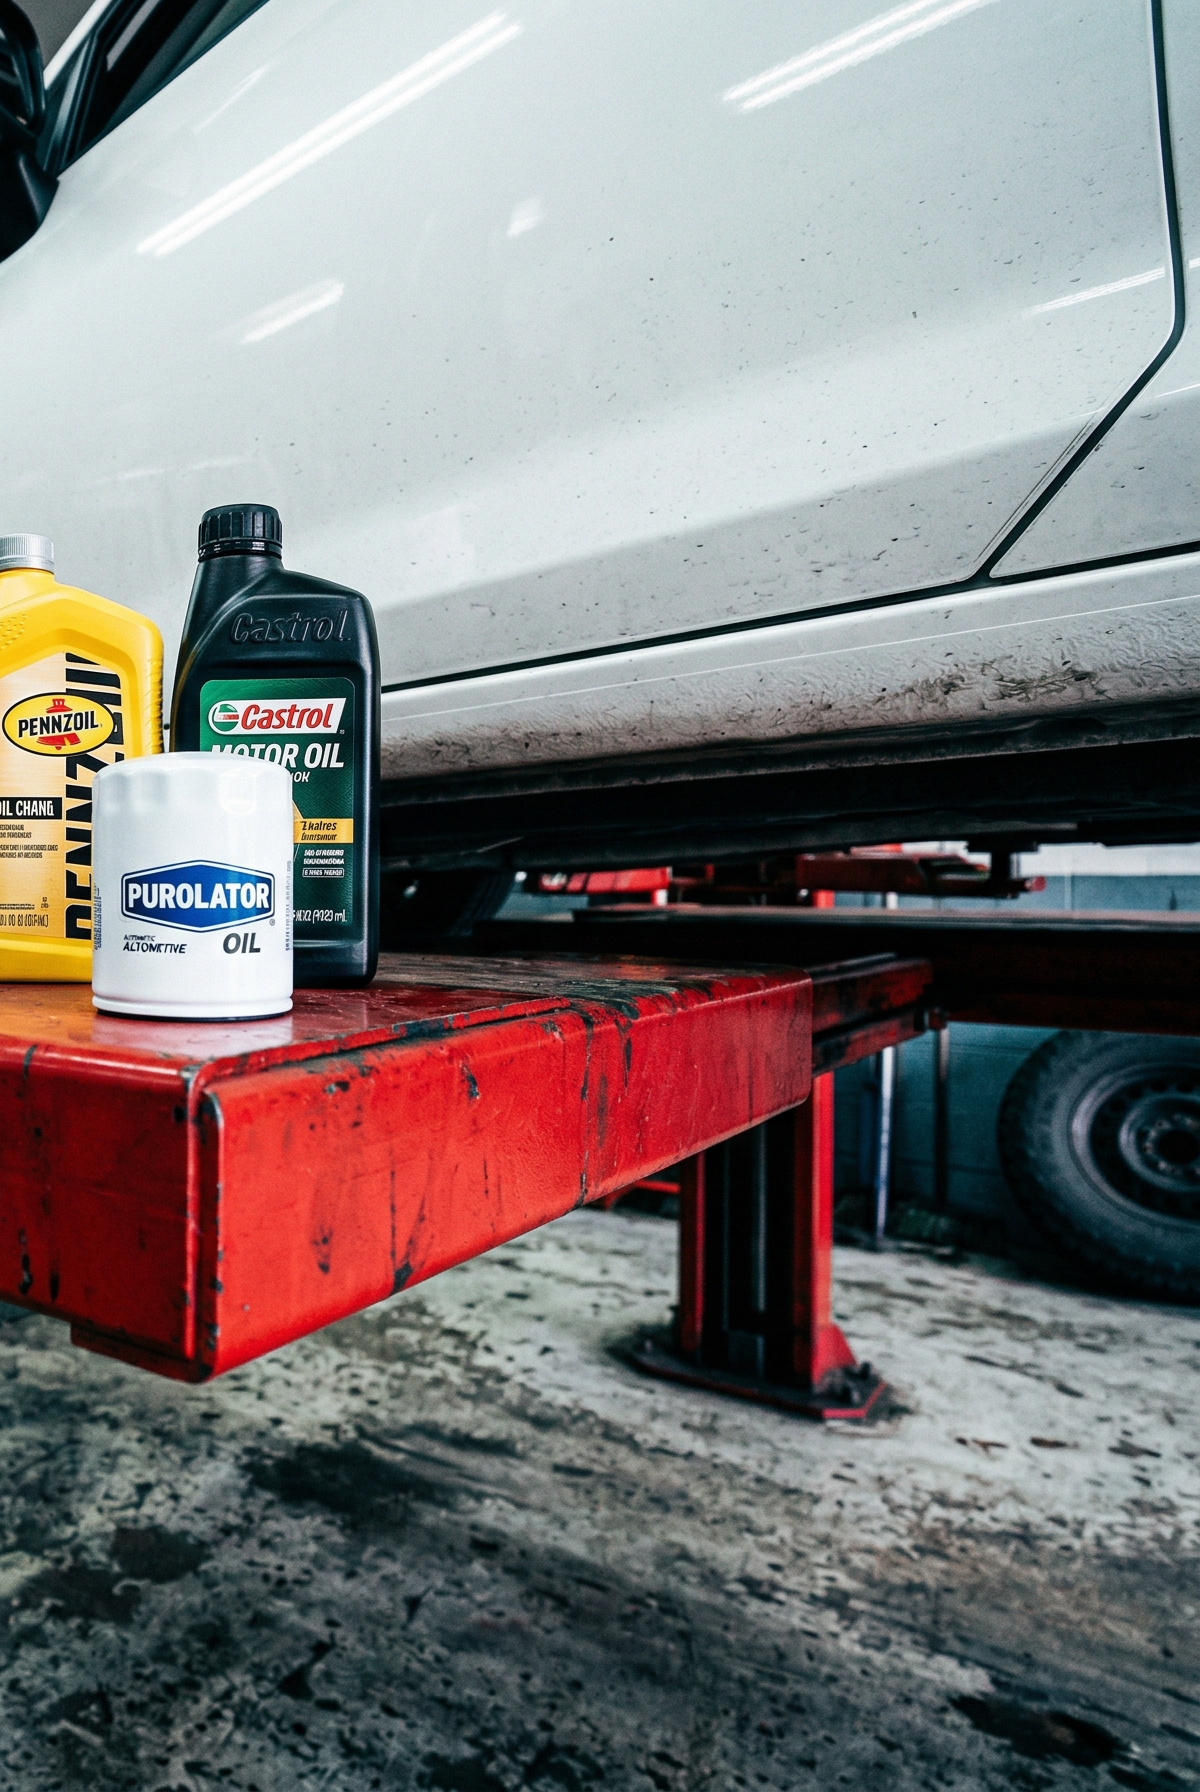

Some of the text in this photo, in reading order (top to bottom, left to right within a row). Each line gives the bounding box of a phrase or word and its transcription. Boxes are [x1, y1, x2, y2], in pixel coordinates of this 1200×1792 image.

[231, 610, 349, 642] Castrol
[18, 710, 99, 738] PENNZOIL
[241, 703, 334, 730] Castrol
[304, 743, 344, 768] OIL
[128, 883, 269, 909] PUROLATOR
[222, 932, 261, 954] OIL
